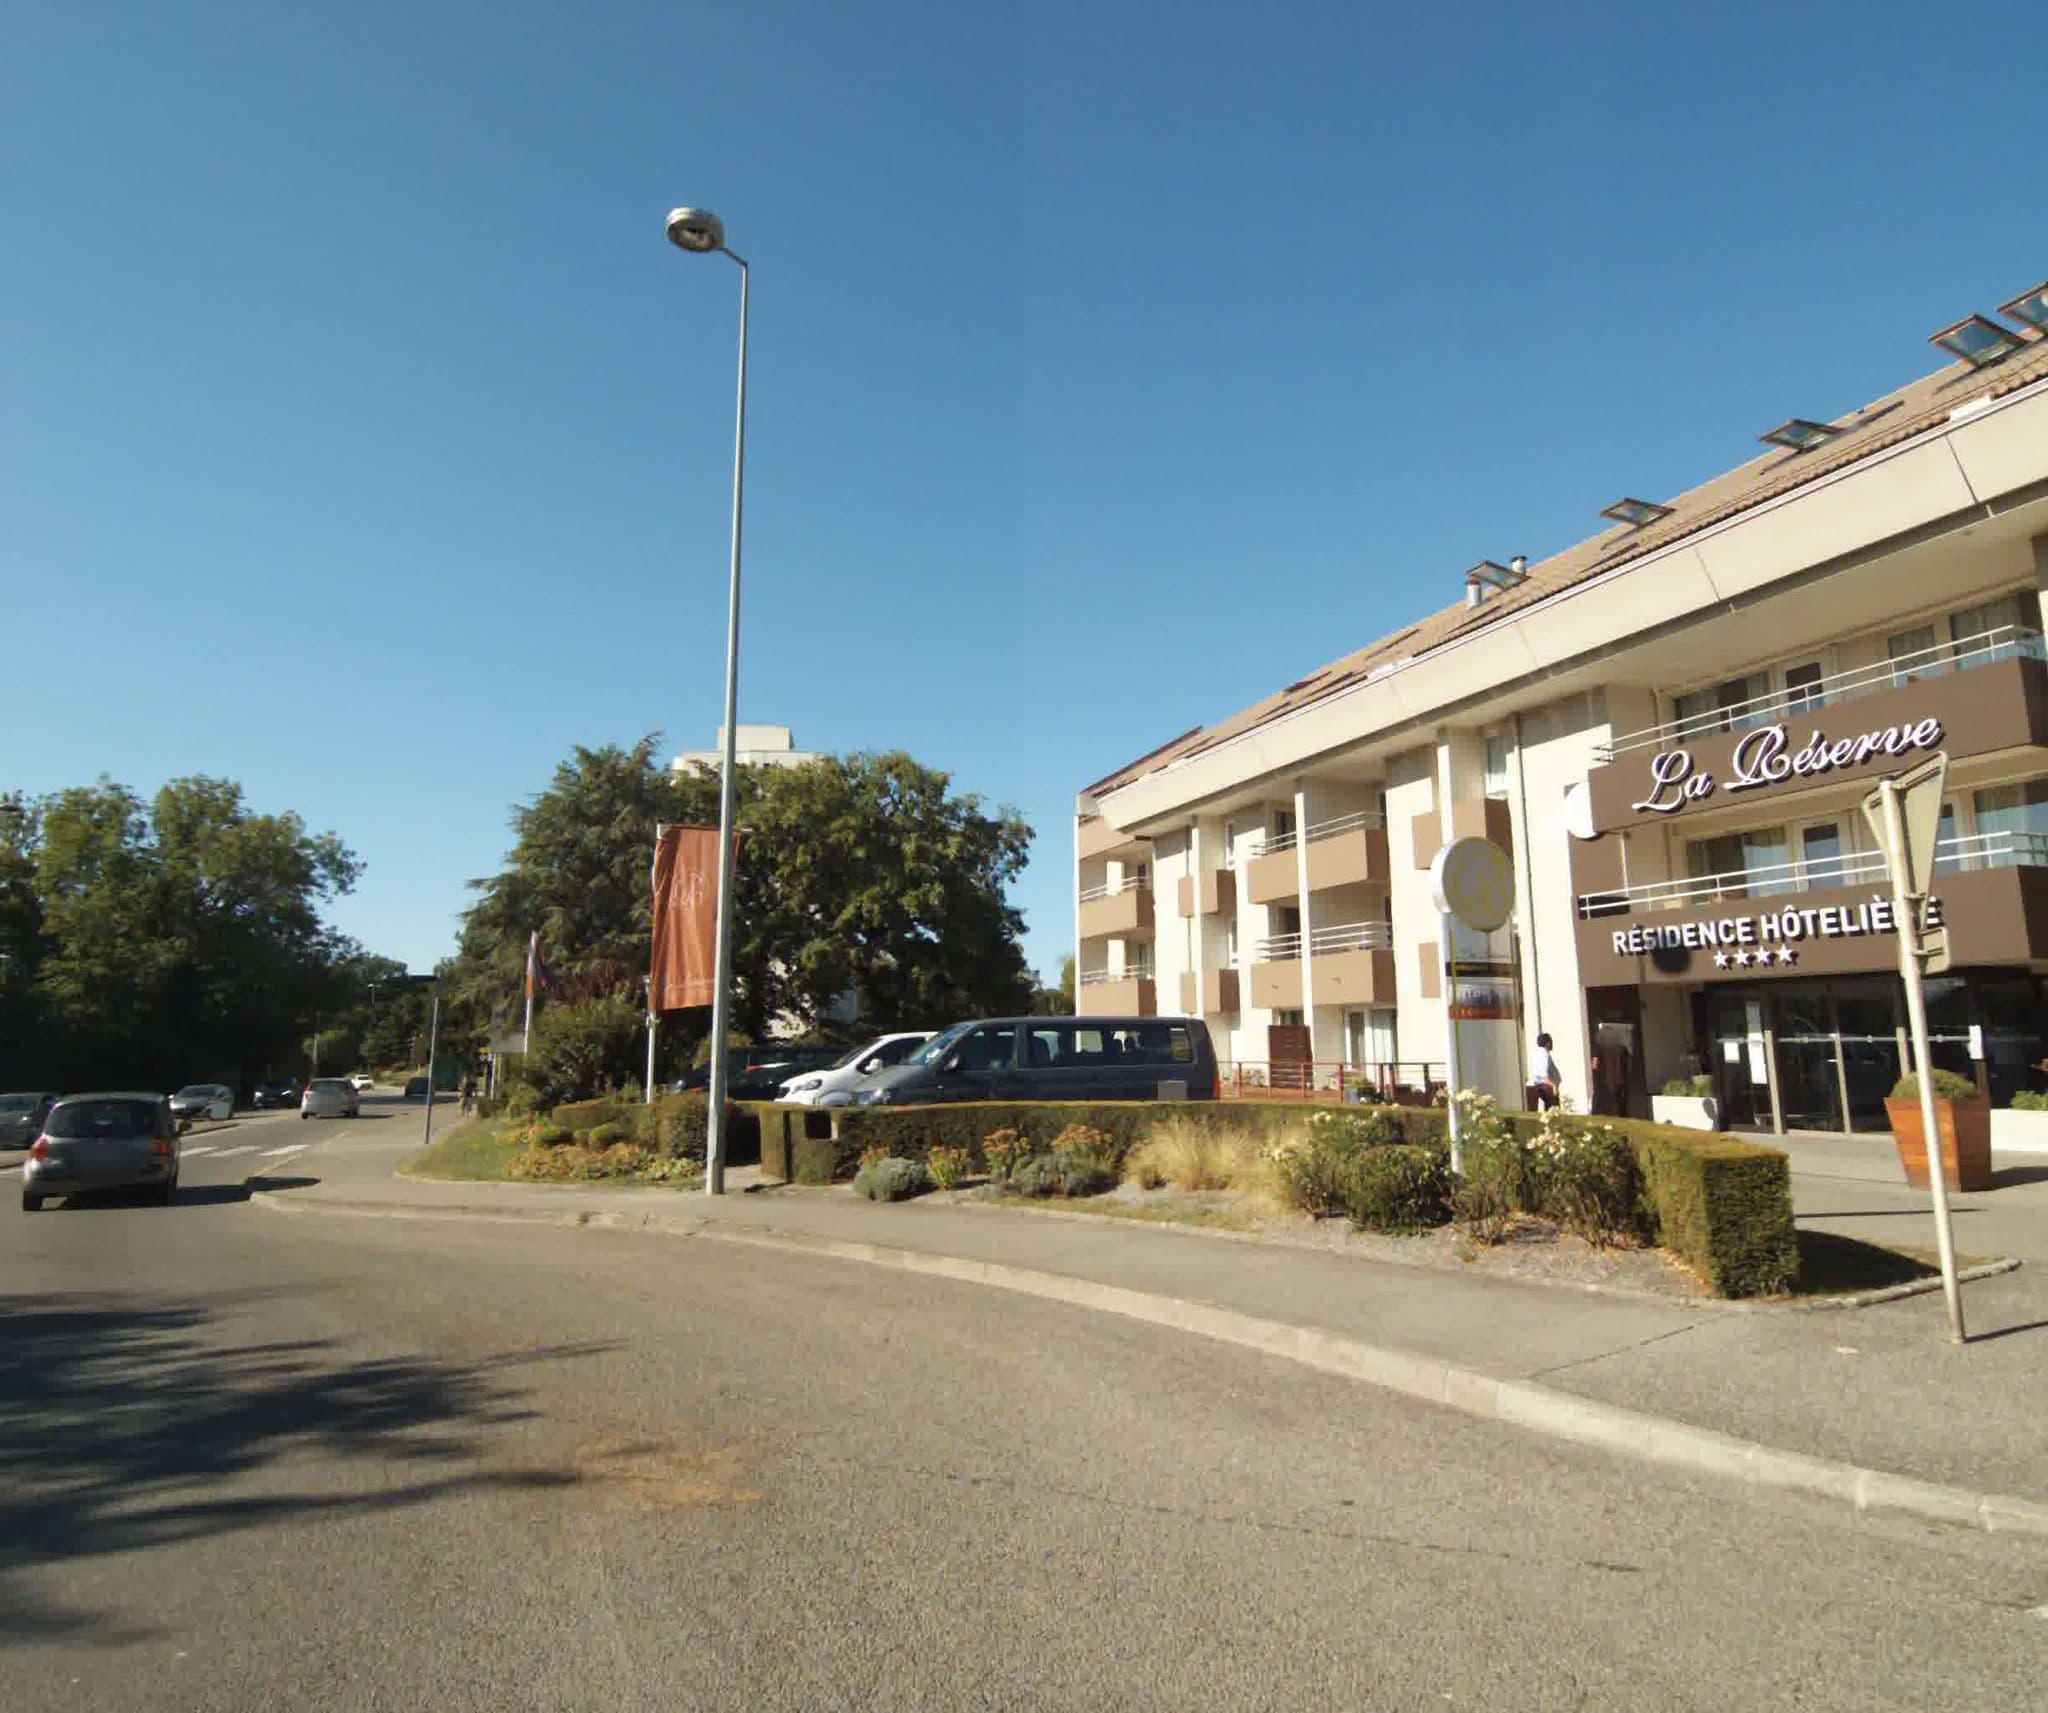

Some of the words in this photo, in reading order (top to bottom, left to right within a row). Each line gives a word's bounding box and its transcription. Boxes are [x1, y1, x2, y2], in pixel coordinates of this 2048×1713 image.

[1632, 750, 1711, 810] La
[1723, 717, 1940, 789] Réserve
[1612, 917, 1753, 953] RÉSIDENCE
